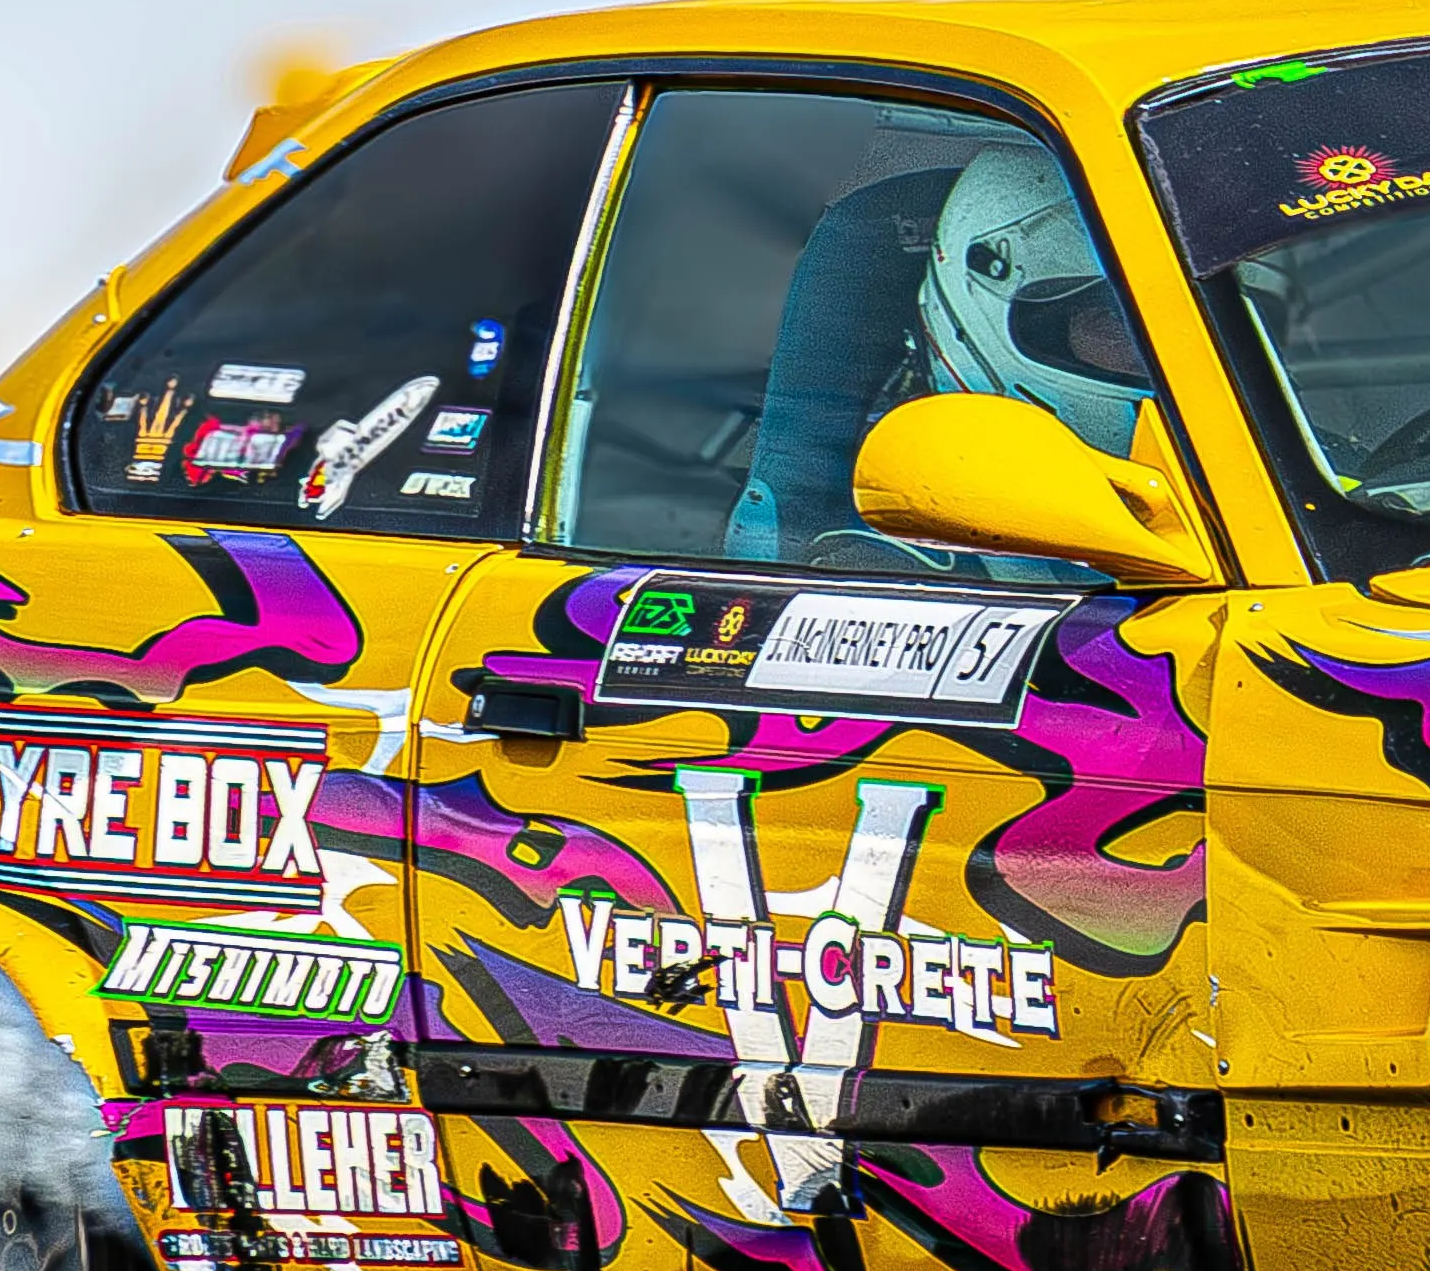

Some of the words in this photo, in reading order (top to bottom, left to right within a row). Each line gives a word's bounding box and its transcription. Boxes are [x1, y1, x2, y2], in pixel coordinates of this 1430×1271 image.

[1278, 179, 1392, 217] LUCKY
[903, 622, 949, 672] PRO
[955, 620, 1026, 682] 57
[153, 752, 328, 876] BOX
[103, 924, 402, 1016] MISHIMOTO
